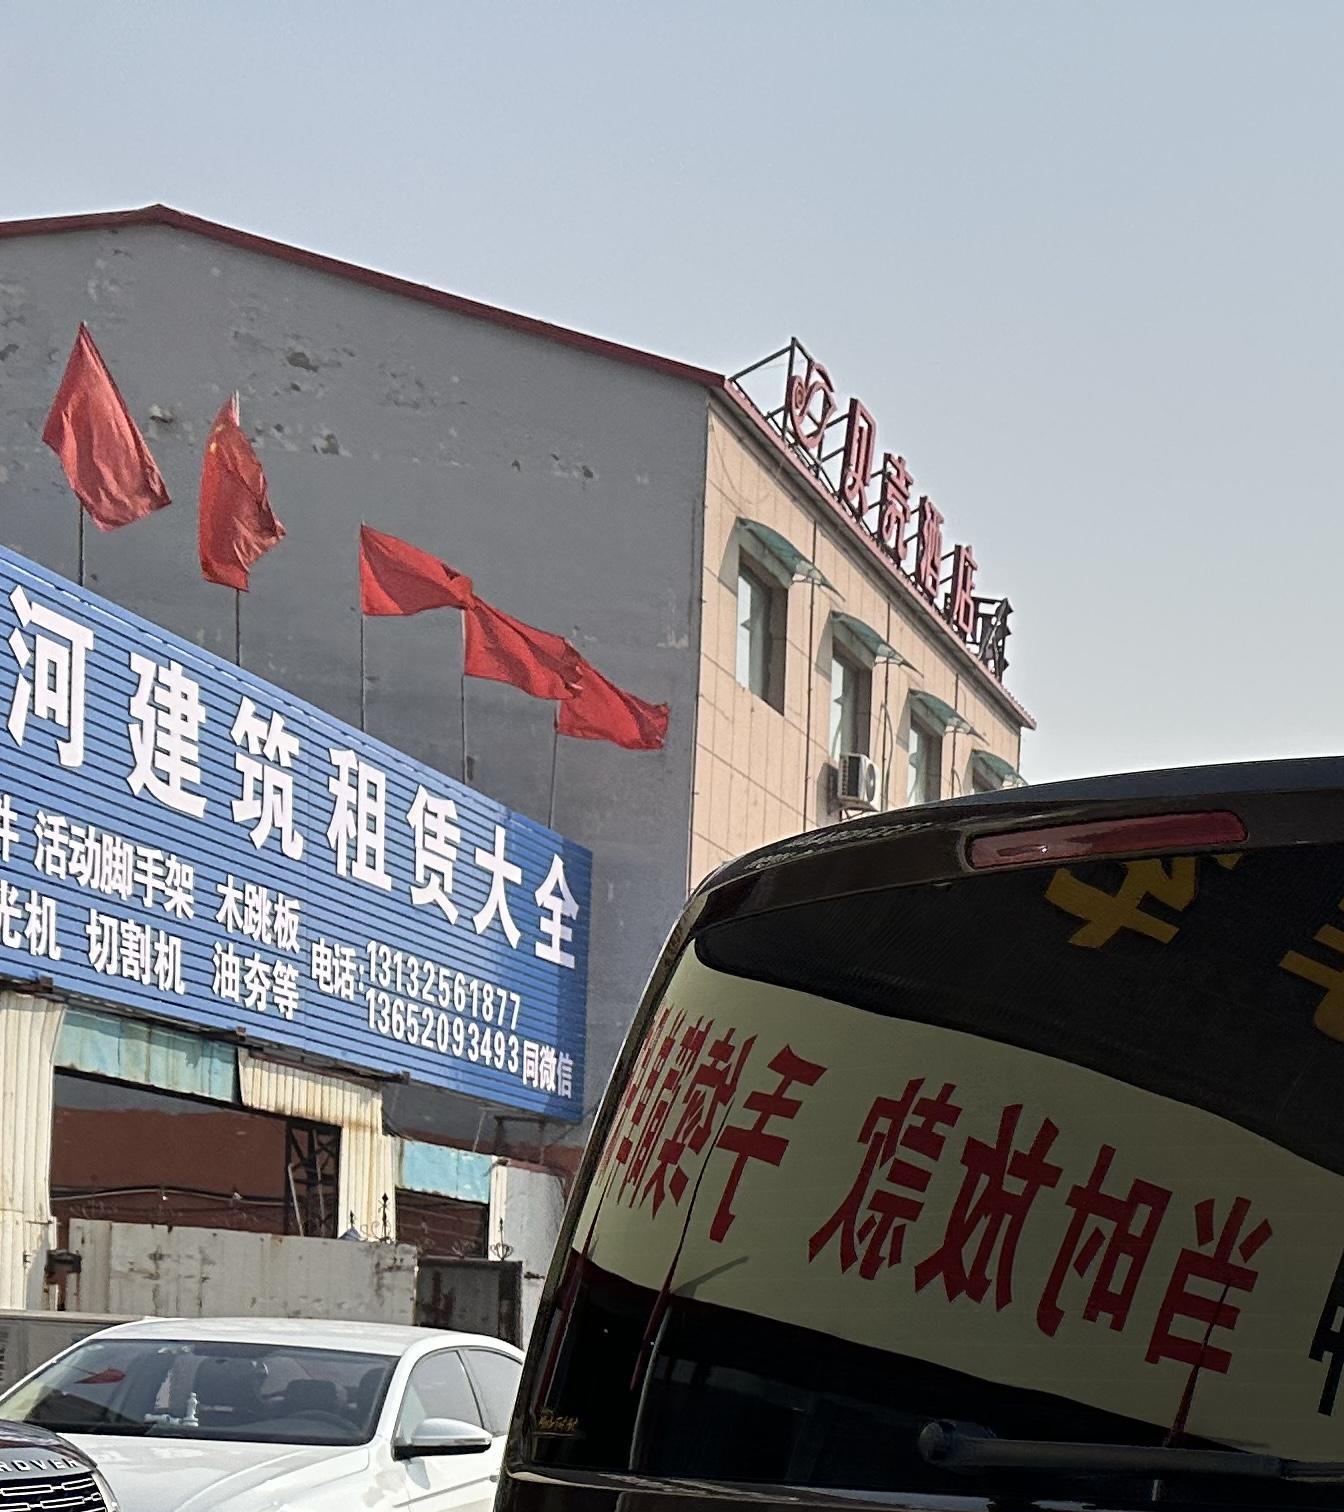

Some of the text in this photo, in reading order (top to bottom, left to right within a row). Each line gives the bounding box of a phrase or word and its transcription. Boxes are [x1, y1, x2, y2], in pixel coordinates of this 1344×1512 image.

[7, 584, 580, 970] 河建筑租赁大全
[33, 809, 195, 920] 活动脚手架
[215, 874, 301, 954] 木跳板
[86, 908, 185, 996] 切割机
[212, 941, 300, 1021] 油夯等
[366, 940, 521, 1030] 13132561877
[365, 988, 574, 1099] 13652093493 同微信
